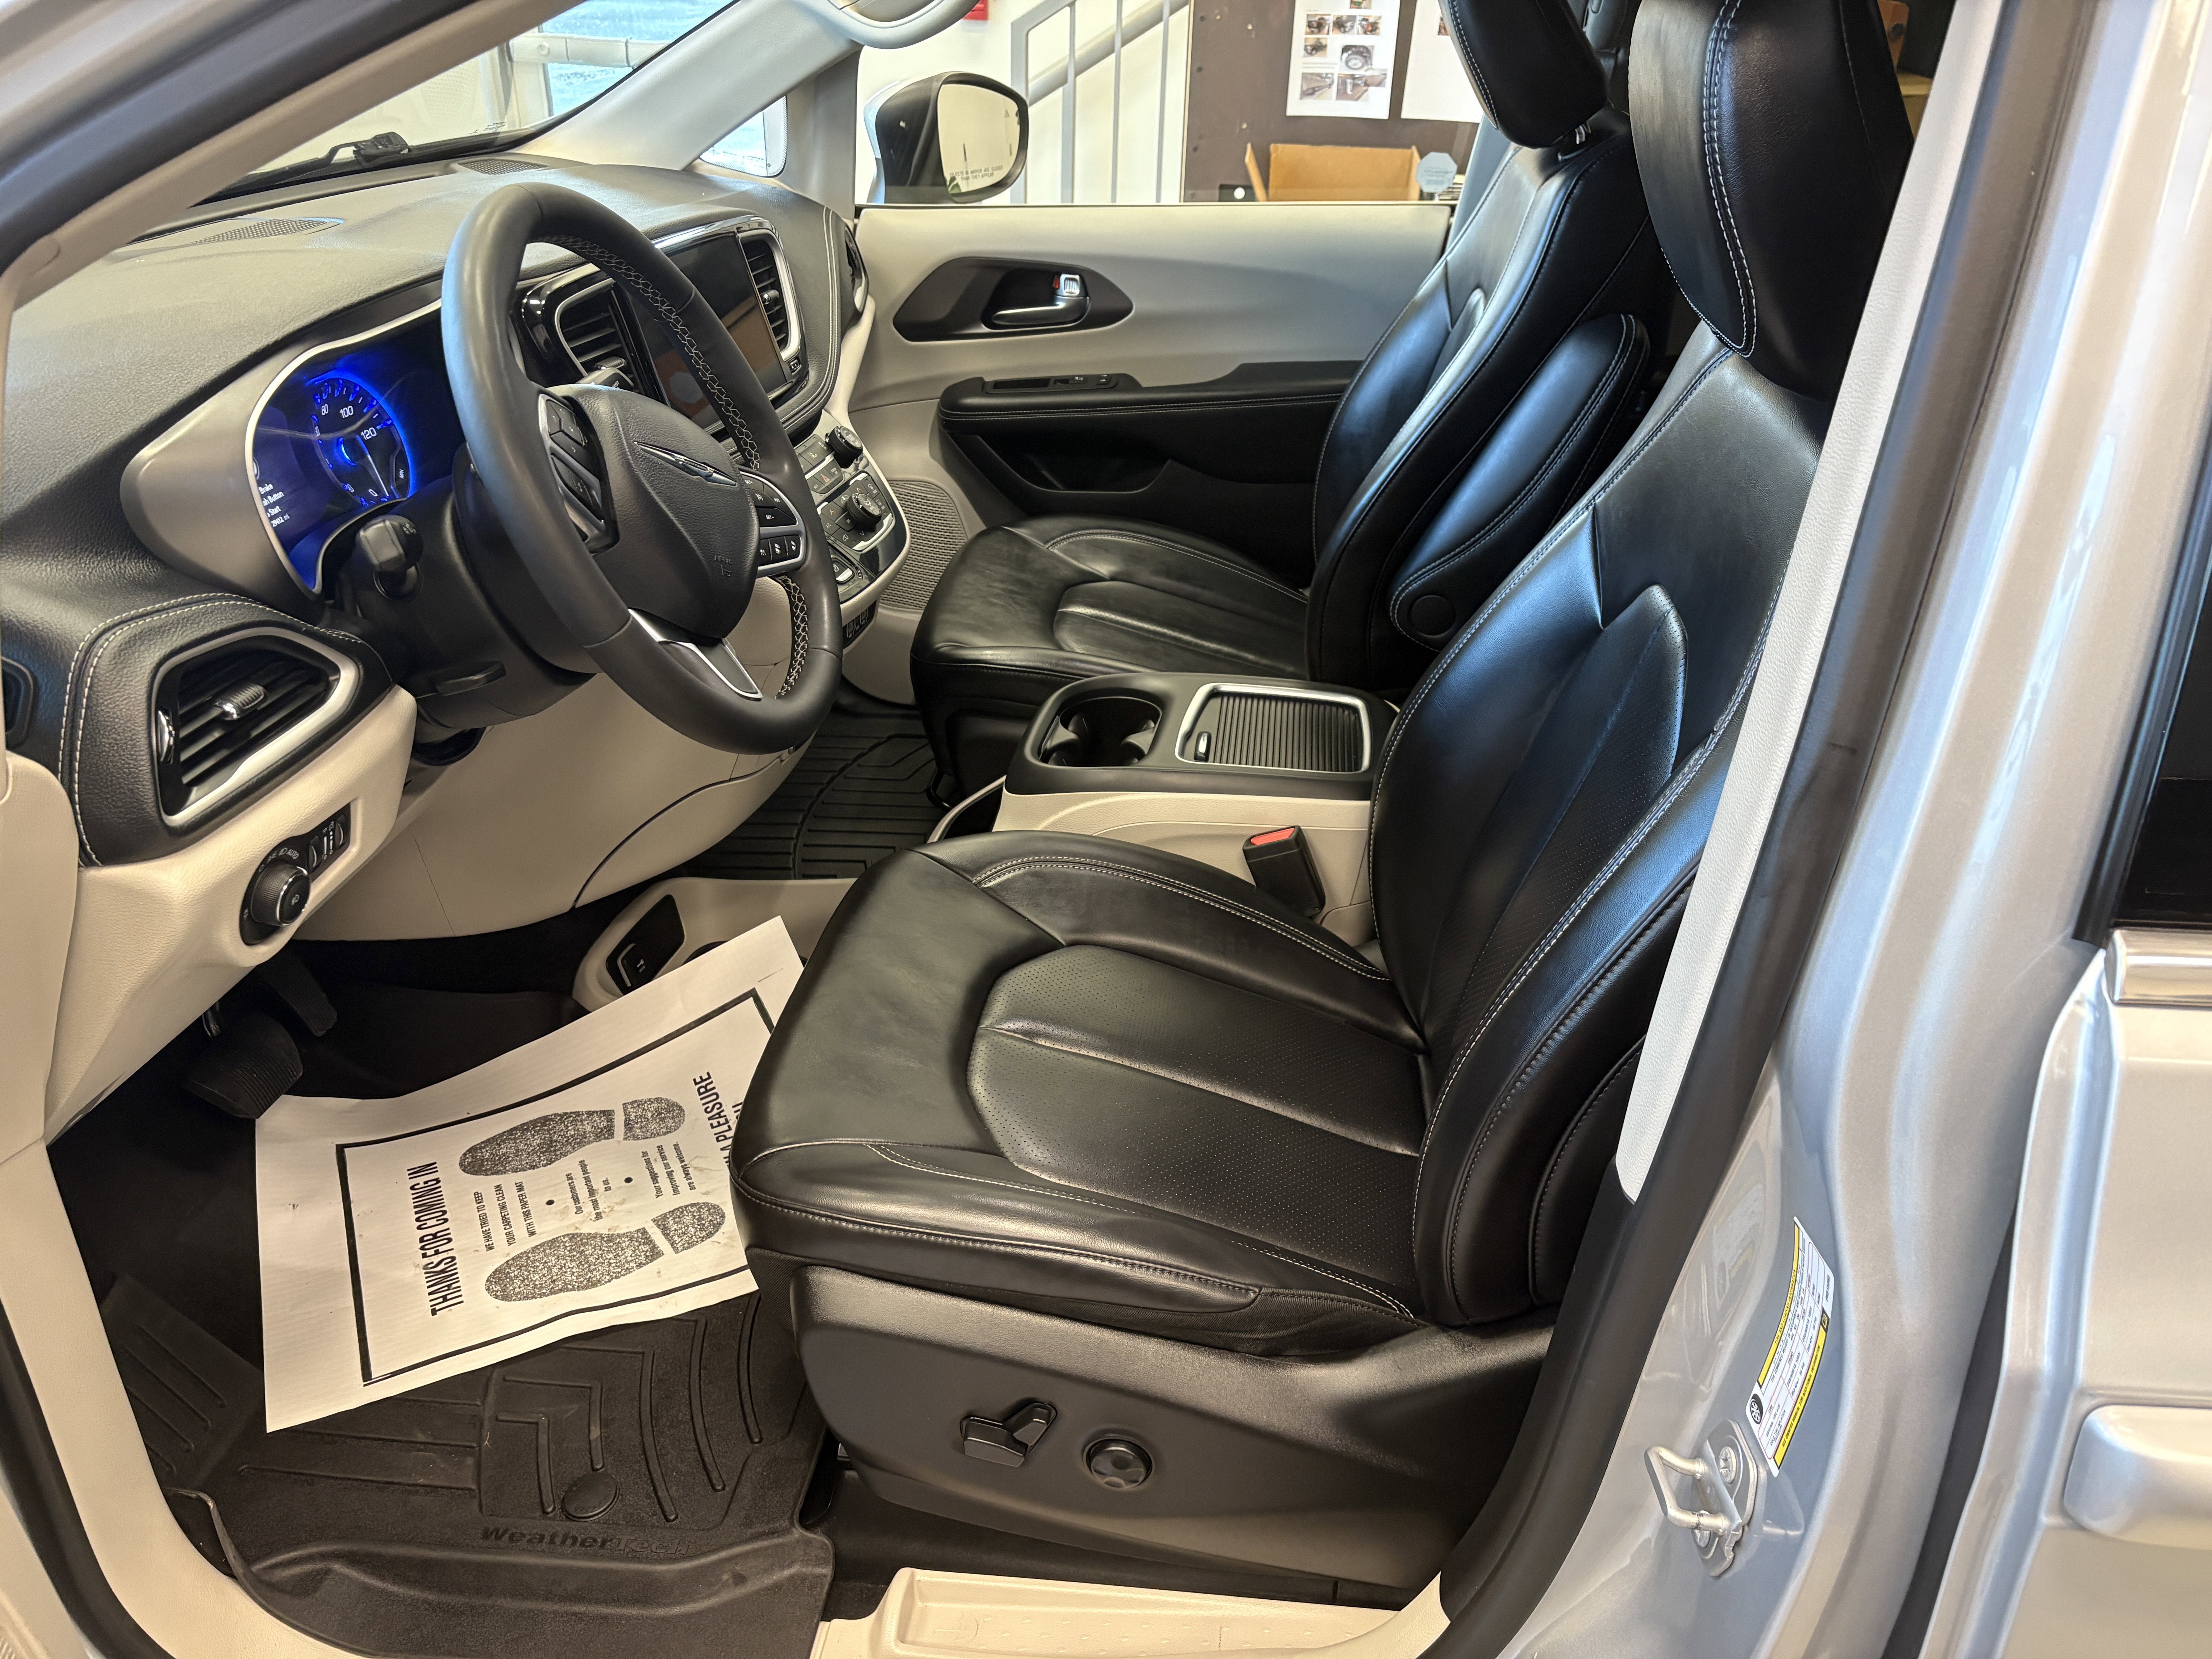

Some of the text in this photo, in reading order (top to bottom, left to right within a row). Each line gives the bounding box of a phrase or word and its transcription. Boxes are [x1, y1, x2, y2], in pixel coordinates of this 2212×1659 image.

[340, 405, 354, 419] 100
[361, 426, 377, 440] 120
[258, 483, 274, 495] Brake
[267, 491, 284, 503] Button
[368, 489, 378, 497] 0
[268, 505, 282, 516] Start
[286, 848, 300, 860] AUTO
[692, 1071, 733, 1143] PLEASURE
[643, 1157, 659, 1185] suggestions
[656, 1144, 680, 1196] improving our service
[673, 1141, 696, 1191] are always welcome.
[565, 1173, 584, 1214] Our customers are
[578, 1159, 603, 1222] the most important people
[602, 1177, 610, 1186] us.
[654, 1185, 663, 1199] Your
[473, 1191, 495, 1252] WE HAVE TRIED TO KEEP
[493, 1183, 516, 1247] YOUR CARPETING CLEAN
[515, 1181, 537, 1237] WITH THIS PAPER MAT
[407, 1161, 464, 1317] THANKS FOR COMING IN
[481, 1525, 693, 1557] WeatherTech
